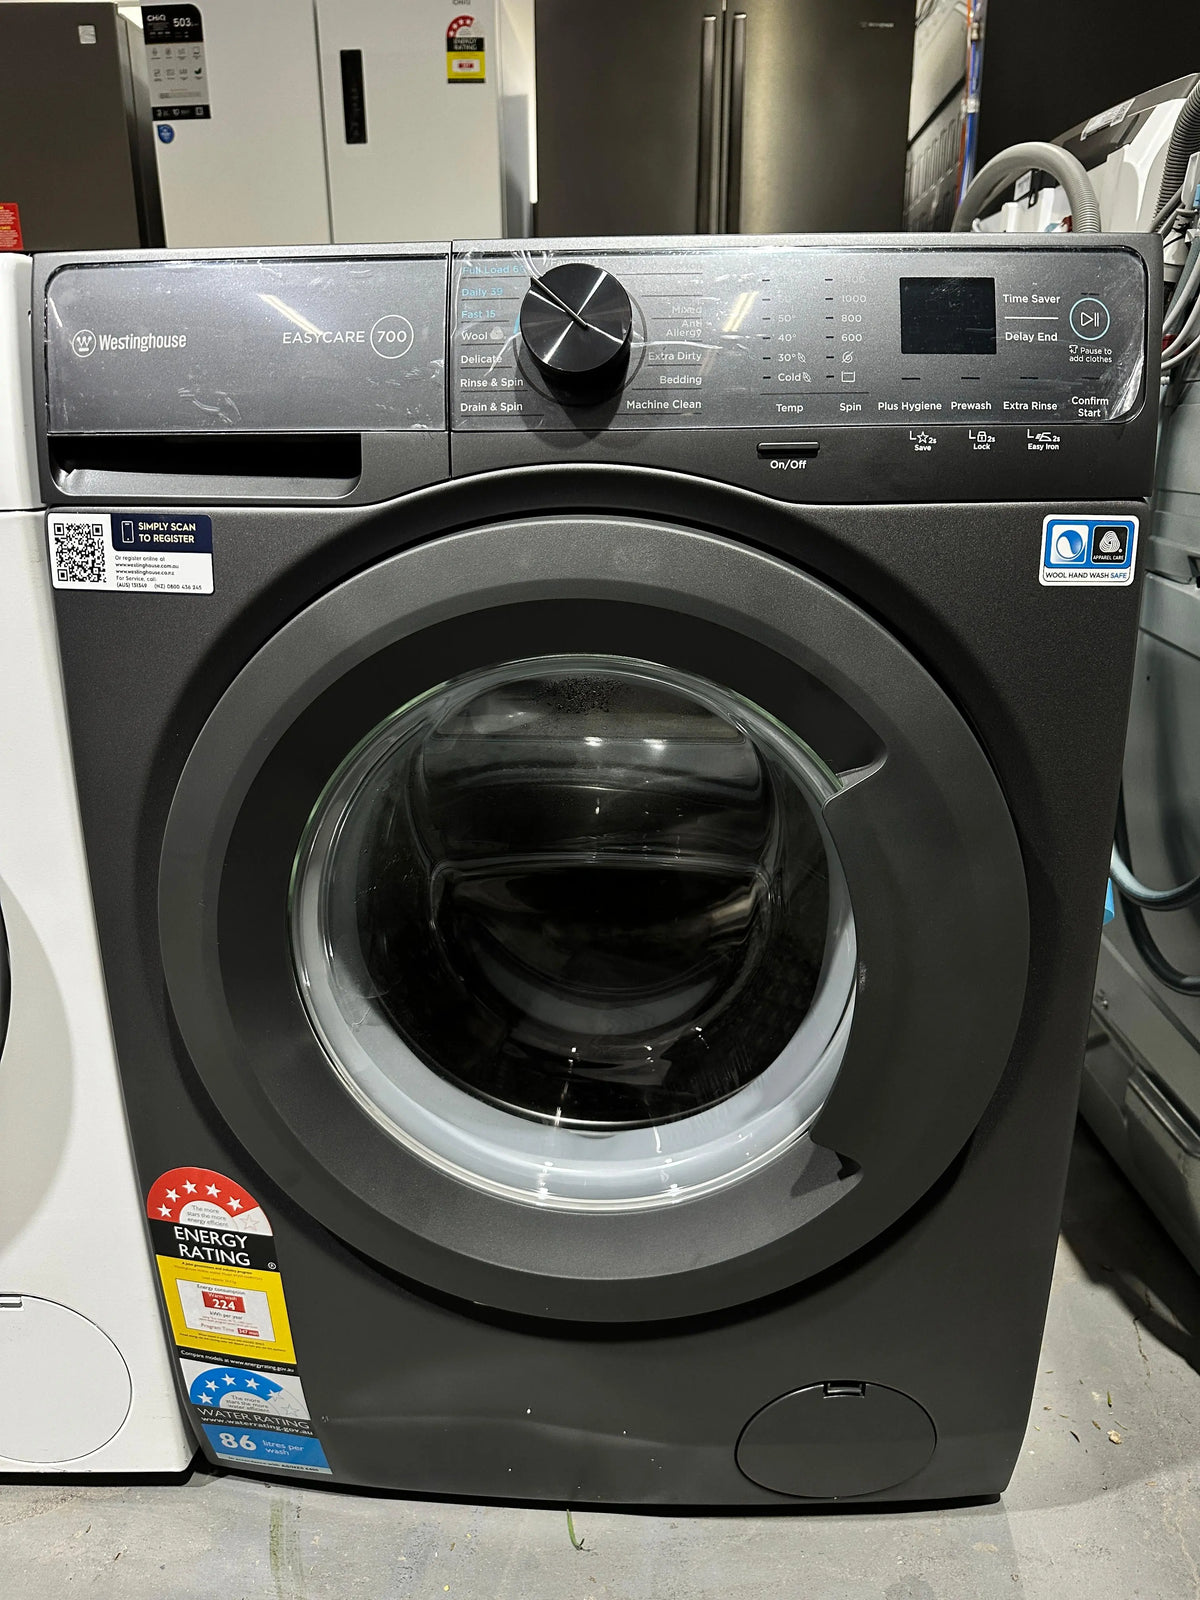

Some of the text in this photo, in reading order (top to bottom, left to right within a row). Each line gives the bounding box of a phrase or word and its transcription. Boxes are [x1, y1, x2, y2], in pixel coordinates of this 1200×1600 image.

[173, 17, 191, 27] 503
[485, 265, 510, 274] Load
[461, 287, 503, 298] Daily 39
[842, 294, 866, 303] 1000
[1003, 294, 1060, 304] Time Saver
[461, 310, 496, 319] Fast 15
[672, 306, 702, 314] Mixed
[841, 314, 862, 323] 800
[282, 330, 408, 344] EASYCARE 700
[461, 331, 488, 340] Wool
[666, 329, 702, 338] Allergy
[778, 333, 797, 342] 40°
[841, 333, 862, 342] 600
[1005, 332, 1058, 343] Delay End
[99, 333, 187, 352] Westinghouse
[648, 351, 702, 361] Extra Dirty
[1080, 347, 1112, 355] Pause to
[460, 354, 503, 364] Delicate
[778, 353, 796, 362] 30°
[1069, 355, 1113, 363] add clothes
[660, 375, 702, 386] Bedding
[778, 373, 801, 382] Cold
[460, 377, 524, 389] Rinse & Spin
[626, 399, 702, 409] Machine Clean
[951, 400, 992, 410] Prewash
[1003, 401, 1058, 410] Extra Rinse
[1071, 396, 1109, 406] Confirm
[460, 401, 523, 413] Drain & Spin
[776, 403, 804, 413] Temp
[839, 402, 862, 413] Spin
[878, 401, 942, 413] Plus Hygiene
[1078, 408, 1101, 417] Start
[1027, 443, 1044, 451] Easy
[770, 459, 807, 471] On/Off
[138, 522, 196, 532] SIMPLY SCAN
[139, 534, 195, 543] TO REGISTER
[173, 1226, 248, 1249] ENERGY
[178, 1243, 251, 1266] RATING
[212, 1299, 236, 1310] 224
[180, 1349, 204, 1358] Compare
[197, 1408, 310, 1430] WATER RATING
[201, 1416, 313, 1436] www.waterrating.gov.au
[219, 1432, 257, 1451] 86
[262, 1440, 286, 1449] litres
[265, 1448, 290, 1456] wash
